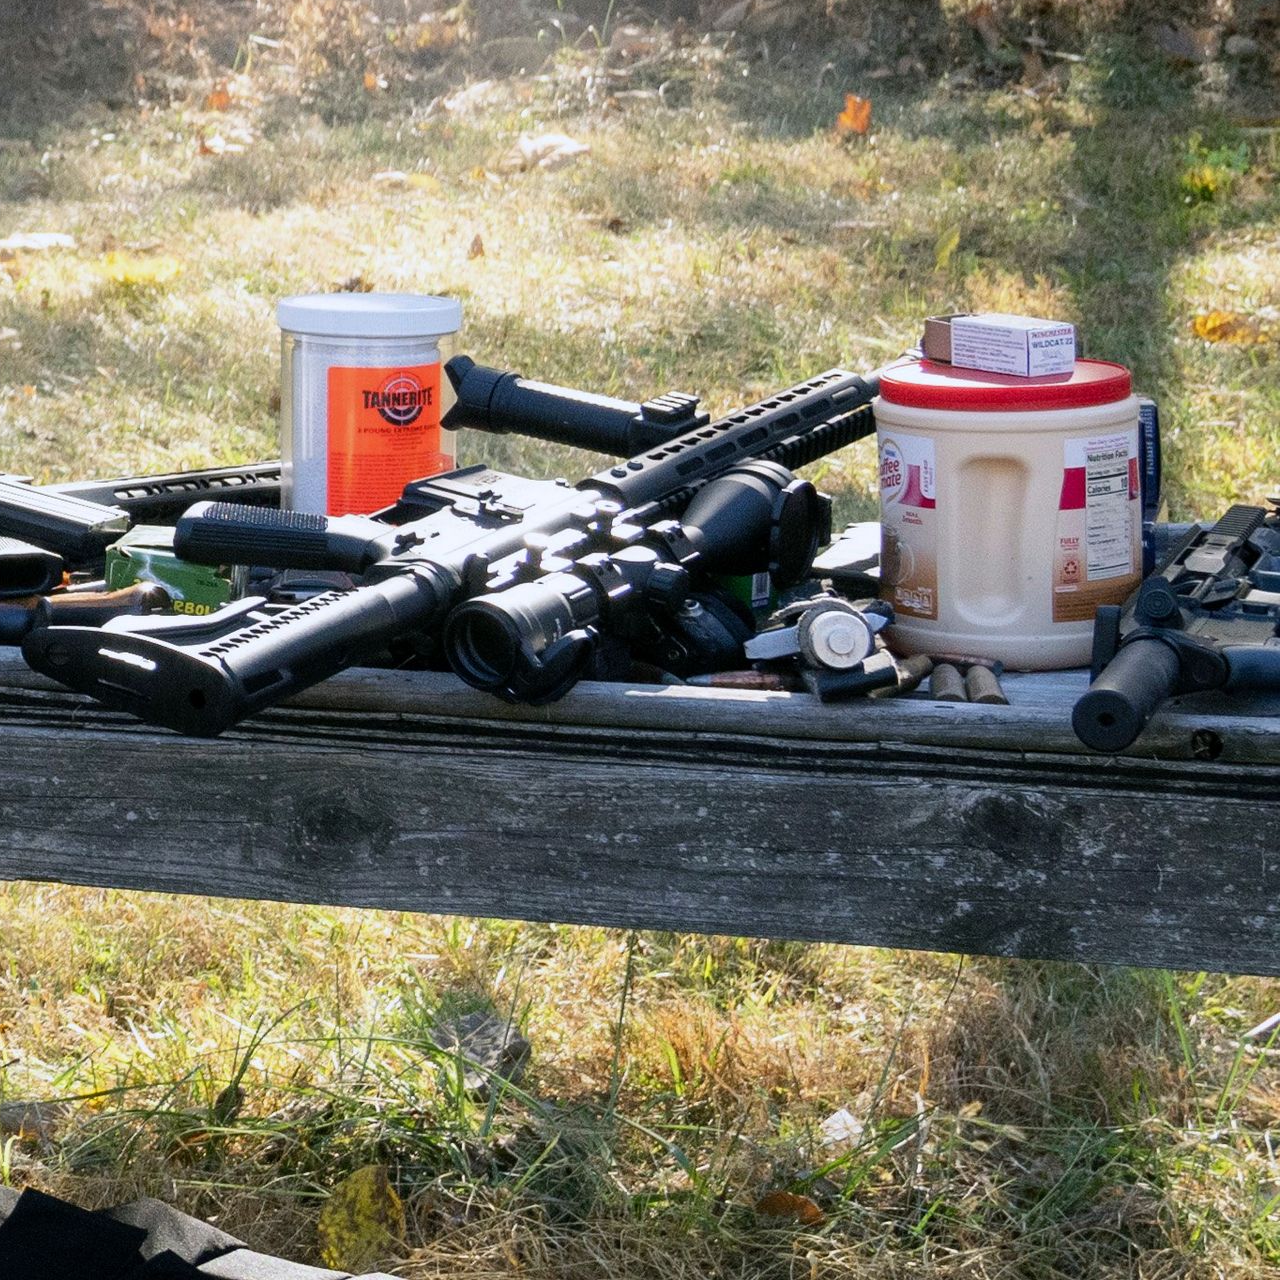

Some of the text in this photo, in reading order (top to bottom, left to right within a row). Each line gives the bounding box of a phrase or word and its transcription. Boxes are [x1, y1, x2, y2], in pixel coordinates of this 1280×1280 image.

[1031, 328, 1072, 338] WINCHESTER
[1032, 337, 1073, 348] WILDCAT 22
[362, 387, 432, 409] TANNERITE
[1087, 449, 1128, 462] Nutrition Facts
[1087, 485, 1111, 494] Calories
